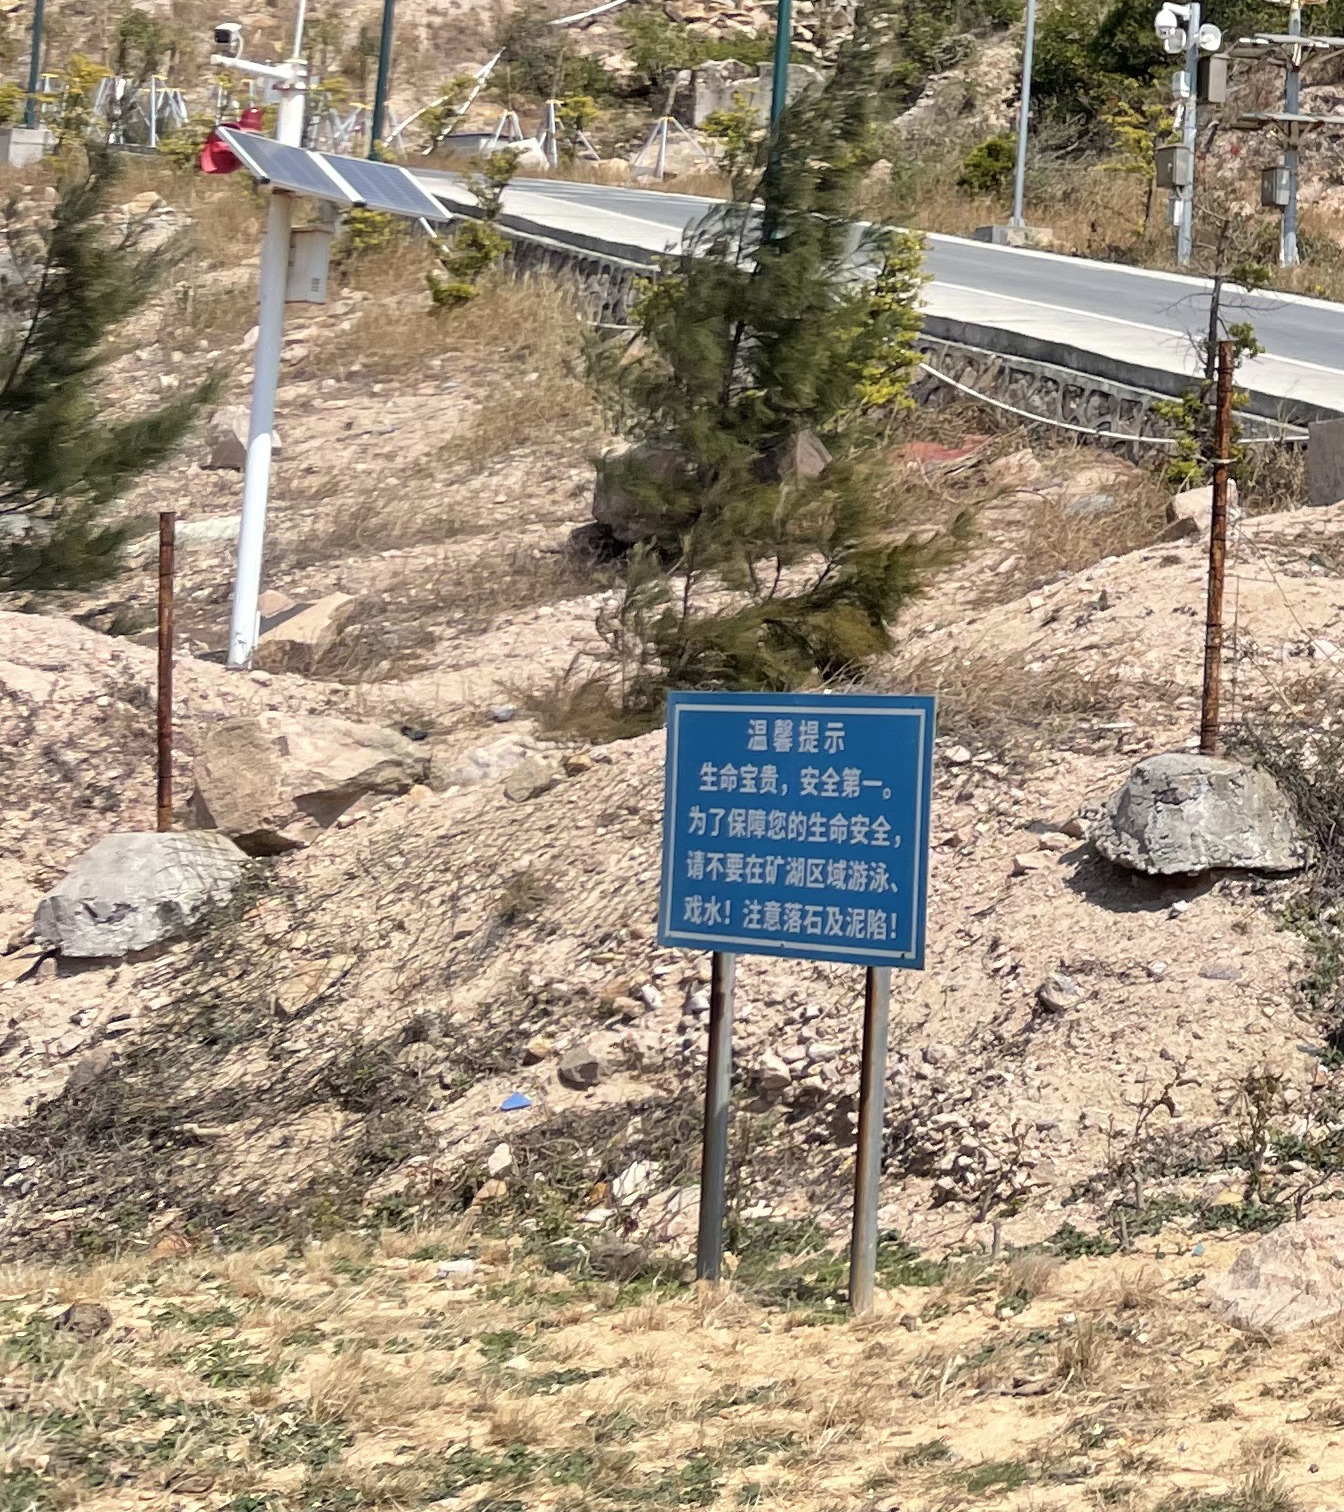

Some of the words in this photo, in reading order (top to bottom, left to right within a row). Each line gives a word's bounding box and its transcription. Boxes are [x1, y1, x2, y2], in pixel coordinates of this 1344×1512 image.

[747, 719, 846, 754] 温馨提示
[699, 761, 892, 800] 生命宝贵，安全第一。
[688, 805, 902, 849] 为了保障您的生命安全，
[686, 850, 898, 894] 请不要在矿湖区域游泳、
[683, 895, 898, 941] 戏水！注意落石及泥陷！
